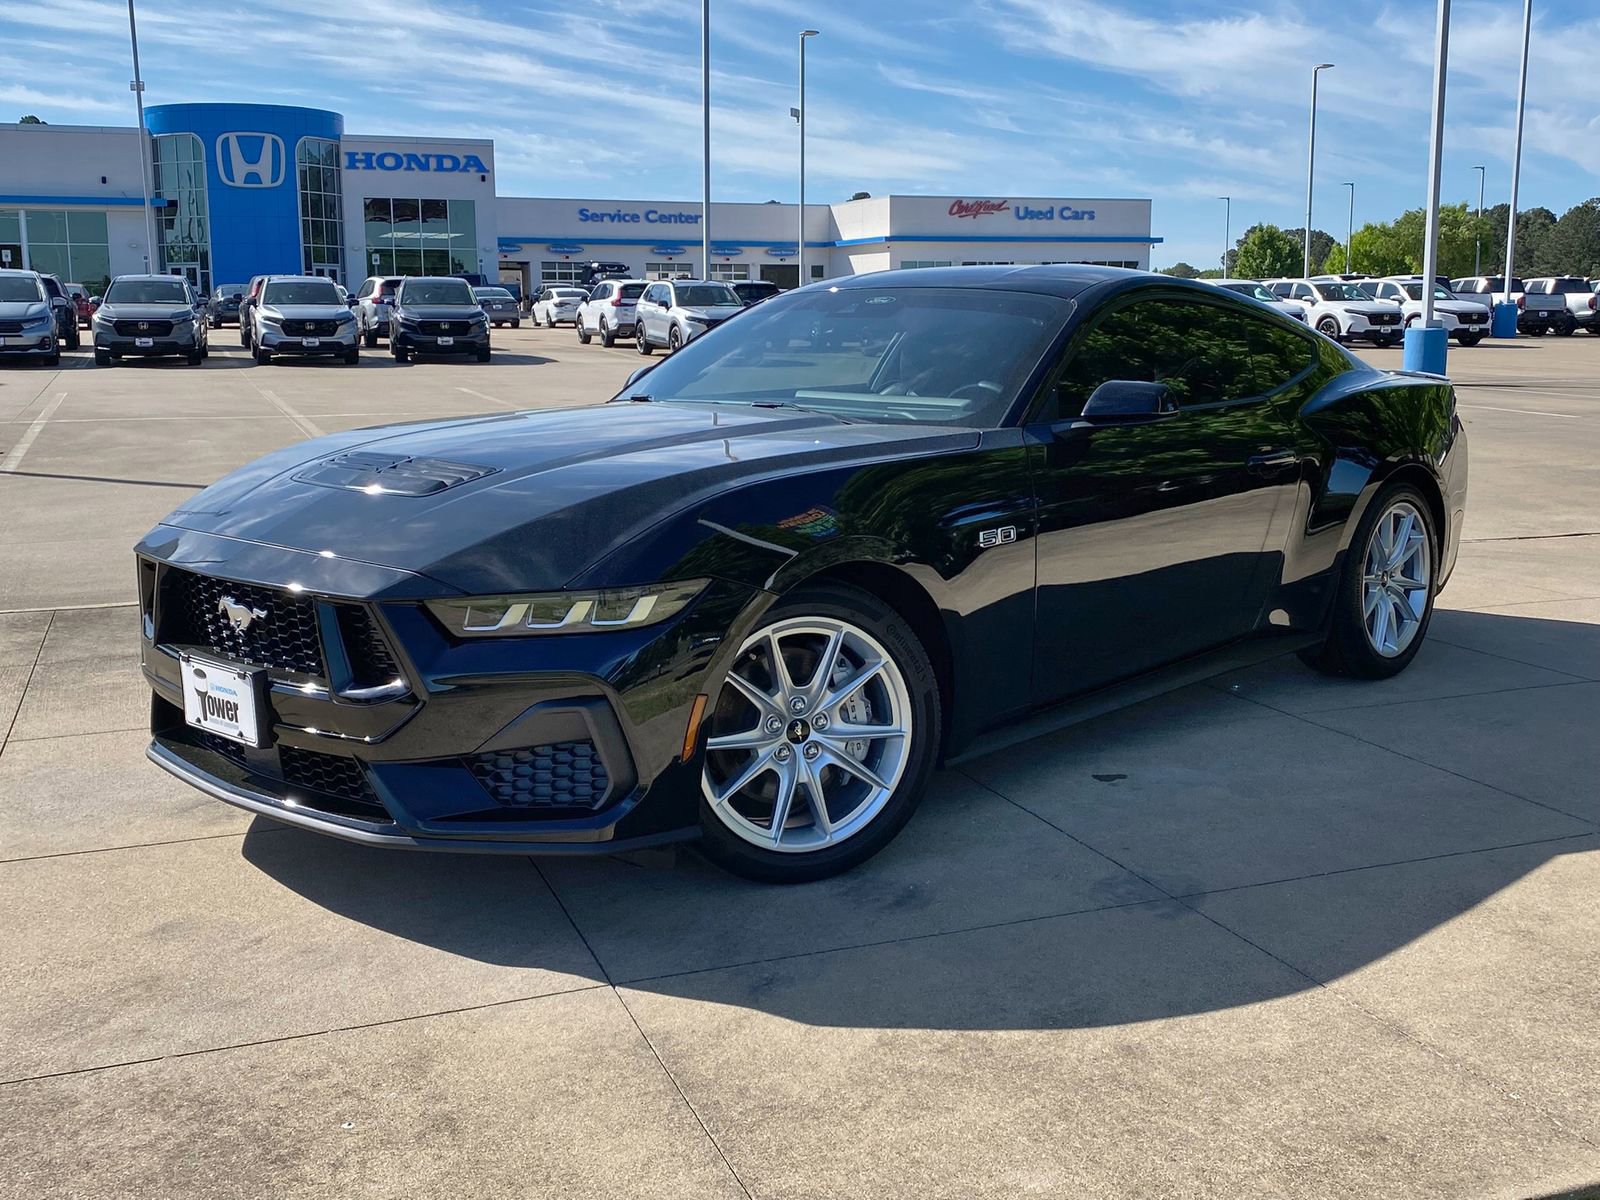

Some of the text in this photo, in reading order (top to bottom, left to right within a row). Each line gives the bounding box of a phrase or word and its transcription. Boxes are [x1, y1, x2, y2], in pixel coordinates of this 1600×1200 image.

[344, 151, 490, 173] HONDA
[577, 207, 703, 224] Service Center
[948, 199, 1096, 221] Certified Used Cars
[195, 688, 239, 723] Tower
